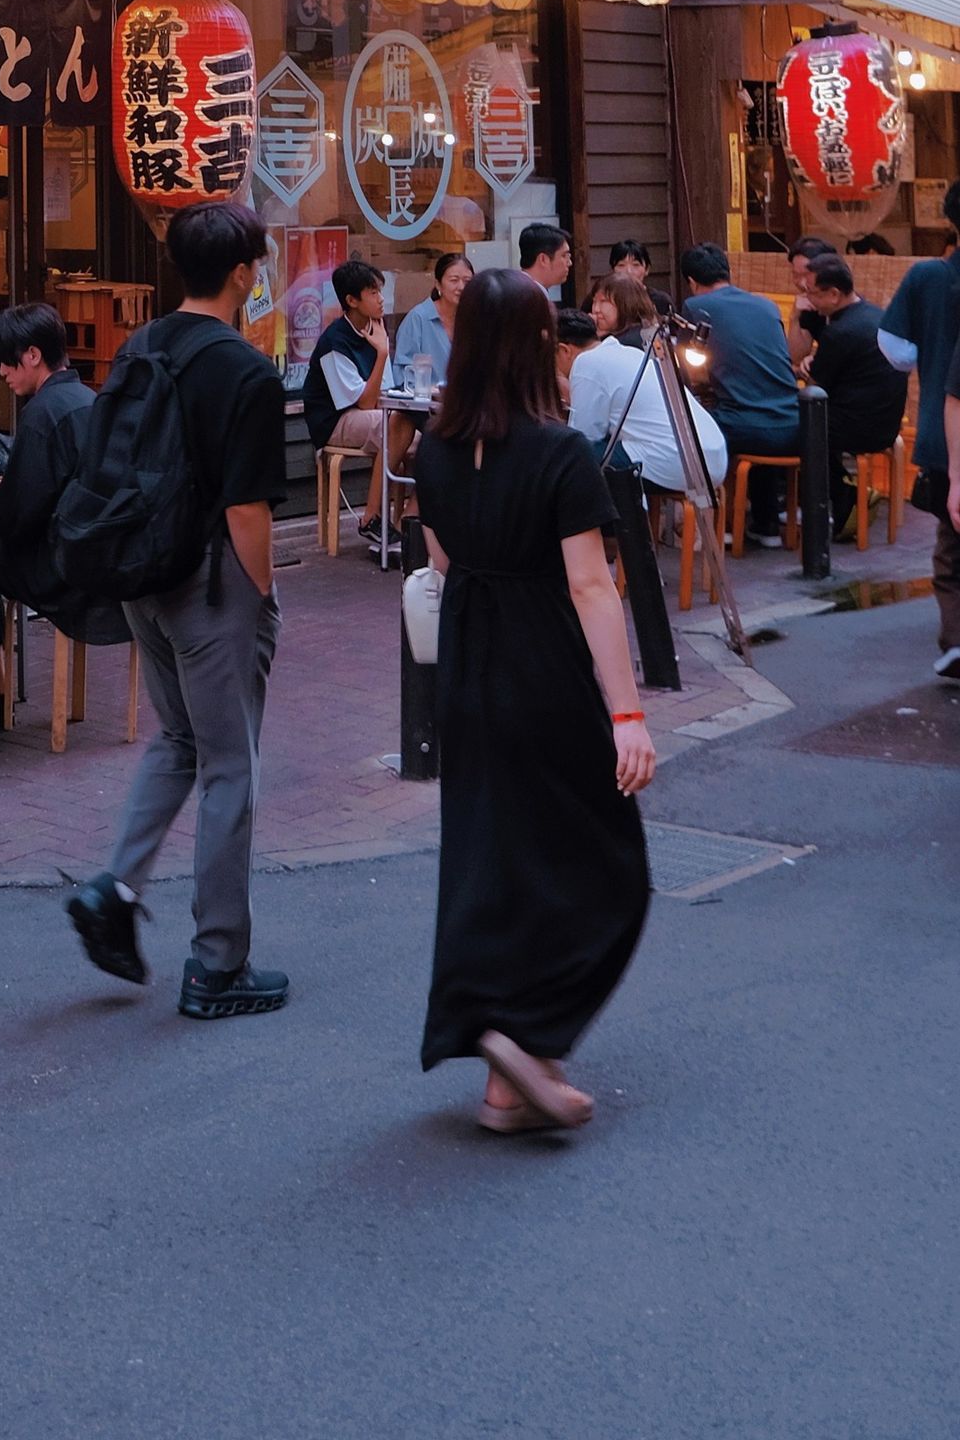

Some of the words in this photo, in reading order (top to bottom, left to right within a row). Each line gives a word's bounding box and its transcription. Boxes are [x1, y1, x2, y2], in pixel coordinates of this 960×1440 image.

[124, 9, 193, 192] 新鮮和豚
[195, 49, 255, 195] 三吉
[259, 88, 318, 177] 三吉
